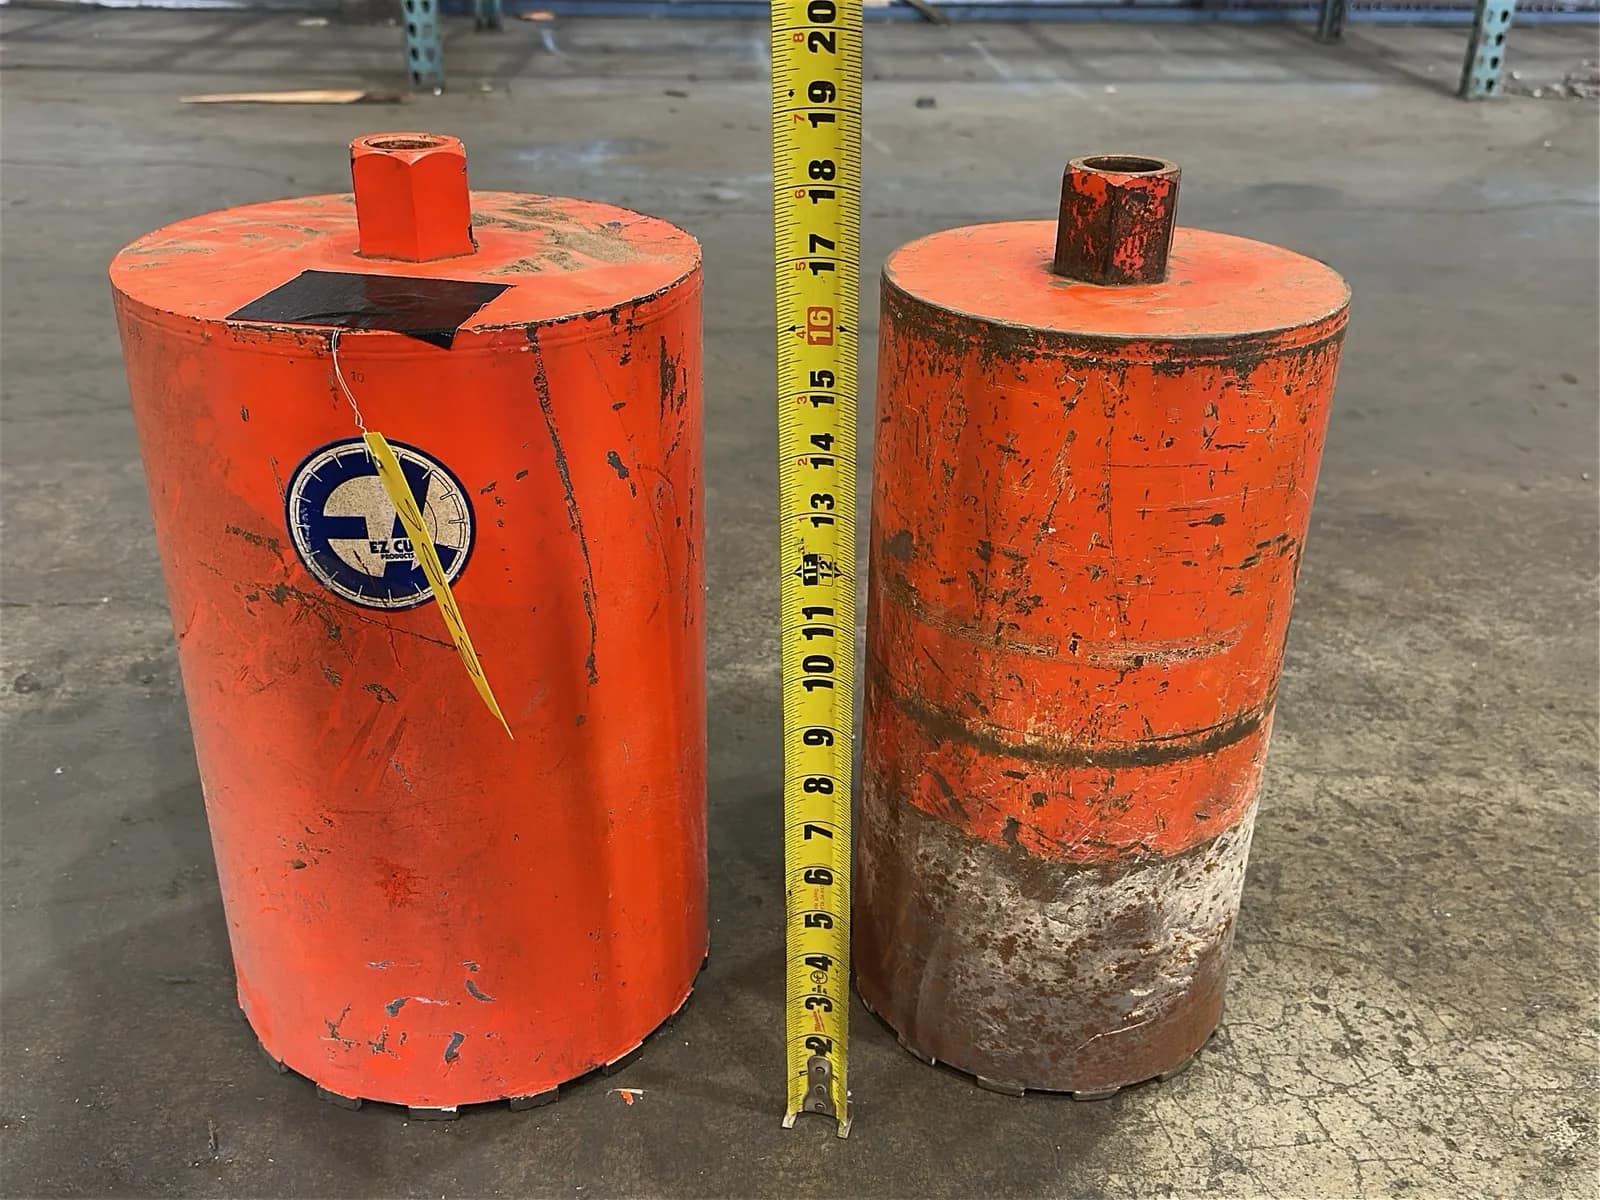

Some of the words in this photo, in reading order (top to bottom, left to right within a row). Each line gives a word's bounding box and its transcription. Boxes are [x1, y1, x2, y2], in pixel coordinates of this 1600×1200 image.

[808, 0, 836, 54] 20
[793, 32, 805, 43] 8
[808, 81, 836, 128] 19
[794, 114, 805, 124] 7
[809, 160, 836, 204] 18
[809, 234, 835, 276] 17
[809, 310, 831, 342] 16
[810, 370, 835, 408] 15
[810, 433, 835, 469] 14
[810, 493, 835, 528] 13
[369, 541, 390, 554] EZ
[393, 540, 414, 553] CU
[804, 561, 817, 579] 1F
[802, 607, 834, 641] 11
[802, 655, 835, 692] 10
[803, 728, 834, 747] 9
[803, 778, 834, 795] 8
[804, 824, 833, 840] 7
[804, 869, 833, 886] 6
[805, 913, 834, 929] 5
[805, 956, 833, 972] 4
[805, 997, 832, 1012] 3
[805, 1037, 832, 1056] 2
